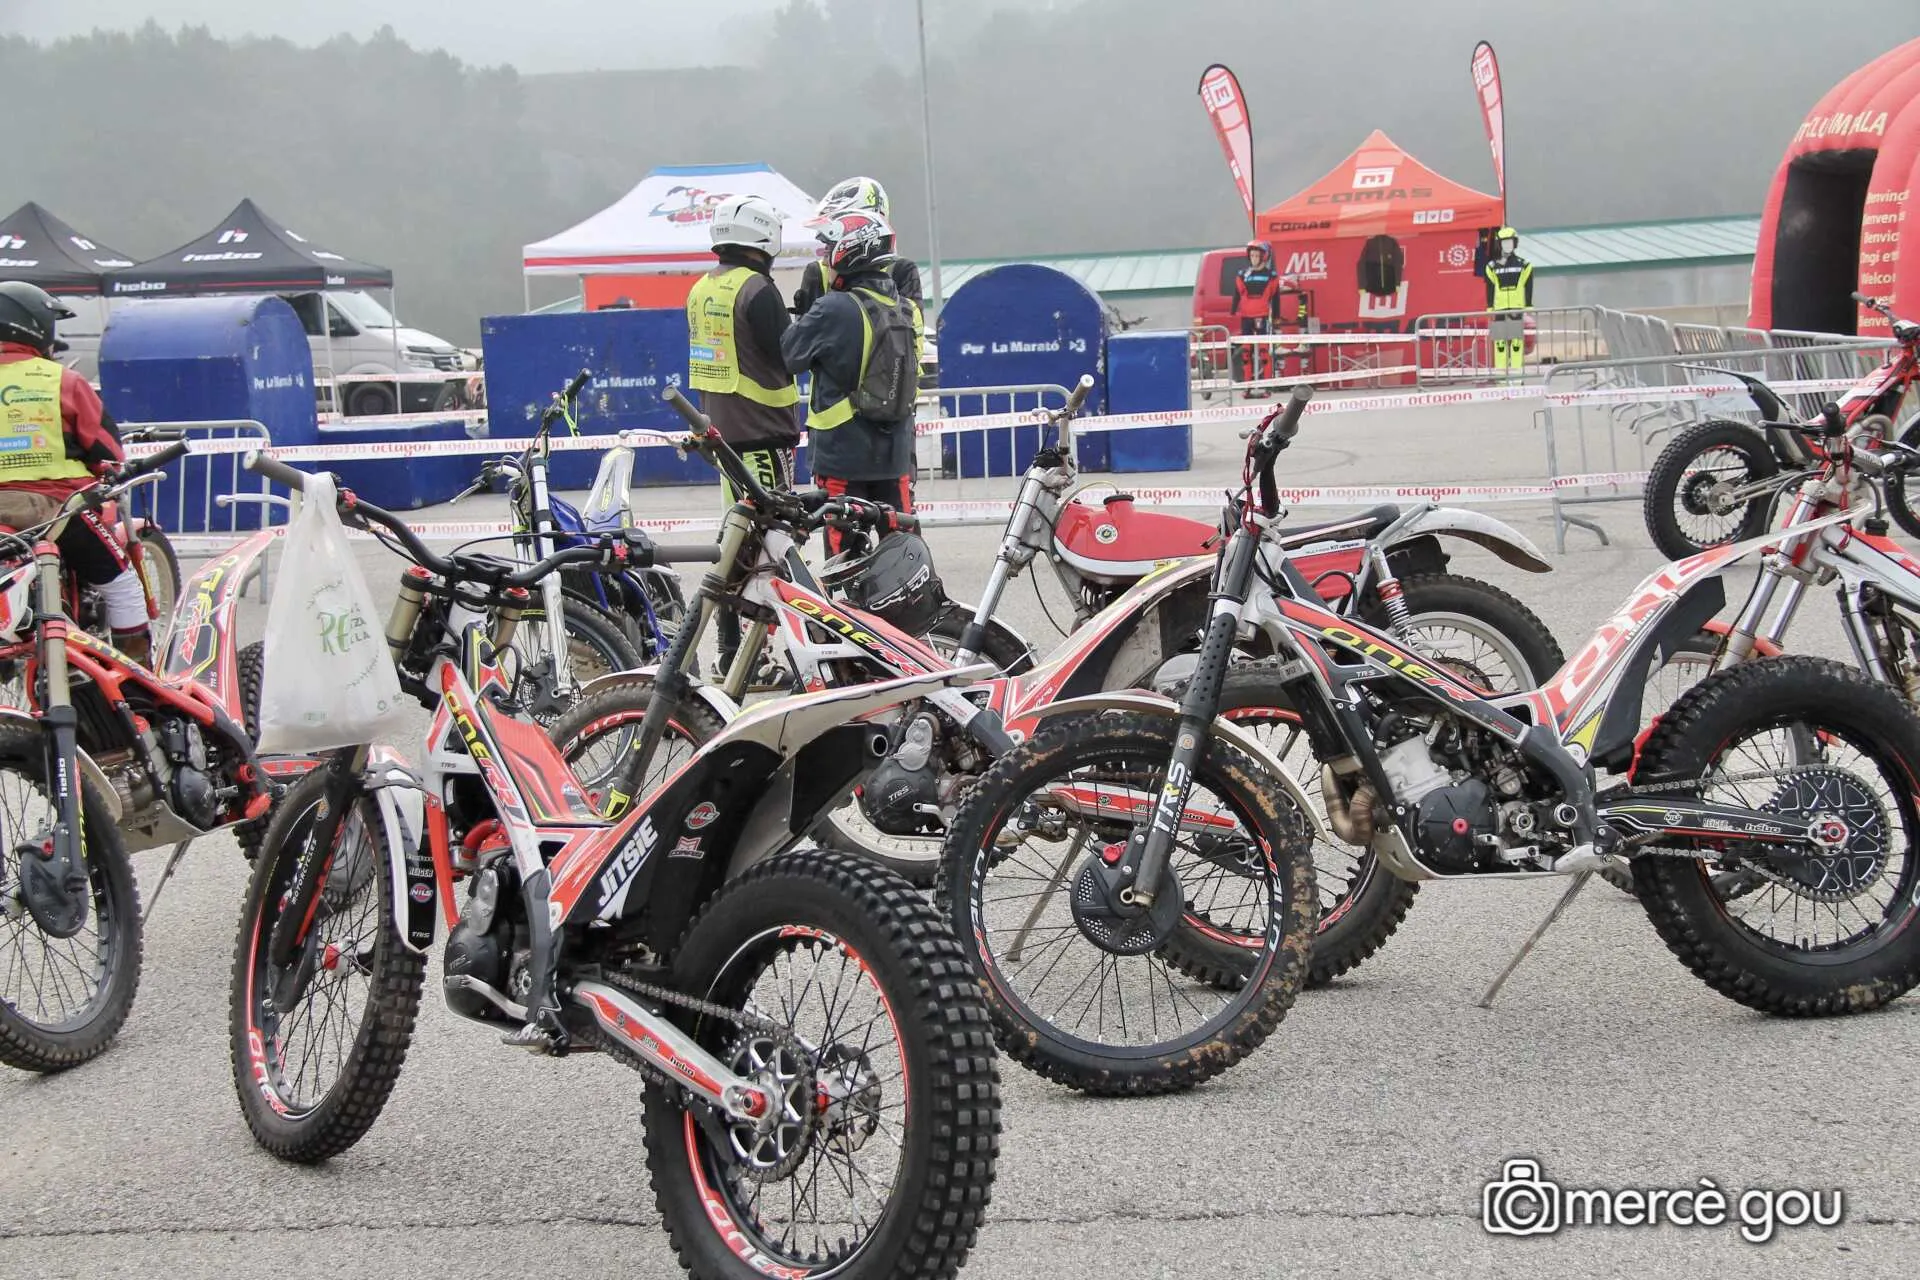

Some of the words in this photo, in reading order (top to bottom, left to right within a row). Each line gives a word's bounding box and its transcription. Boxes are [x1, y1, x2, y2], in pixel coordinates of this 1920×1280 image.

[1307, 188, 1432, 205] COMAS
[1269, 221, 1331, 232] COMAS
[181, 251, 263, 262] hebo
[113, 281, 167, 292] hebo
[992, 342, 1009, 353] La
[1010, 339, 1060, 353] Marató
[592, 377, 608, 389] La
[609, 375, 656, 388] Marató
[1408, 392, 1473, 406] octagon
[1131, 410, 1193, 425] octagon
[371, 441, 432, 458] octagon
[1118, 487, 1183, 504] octagon
[1396, 486, 1461, 501] octagon
[1356, 670, 1376, 678] TRS
[888, 785, 911, 801] TRS
[1153, 759, 1186, 833] TRS
[1744, 823, 1781, 833] hebo
[409, 888, 434, 898] NILS
[670, 1055, 695, 1077] hebo
